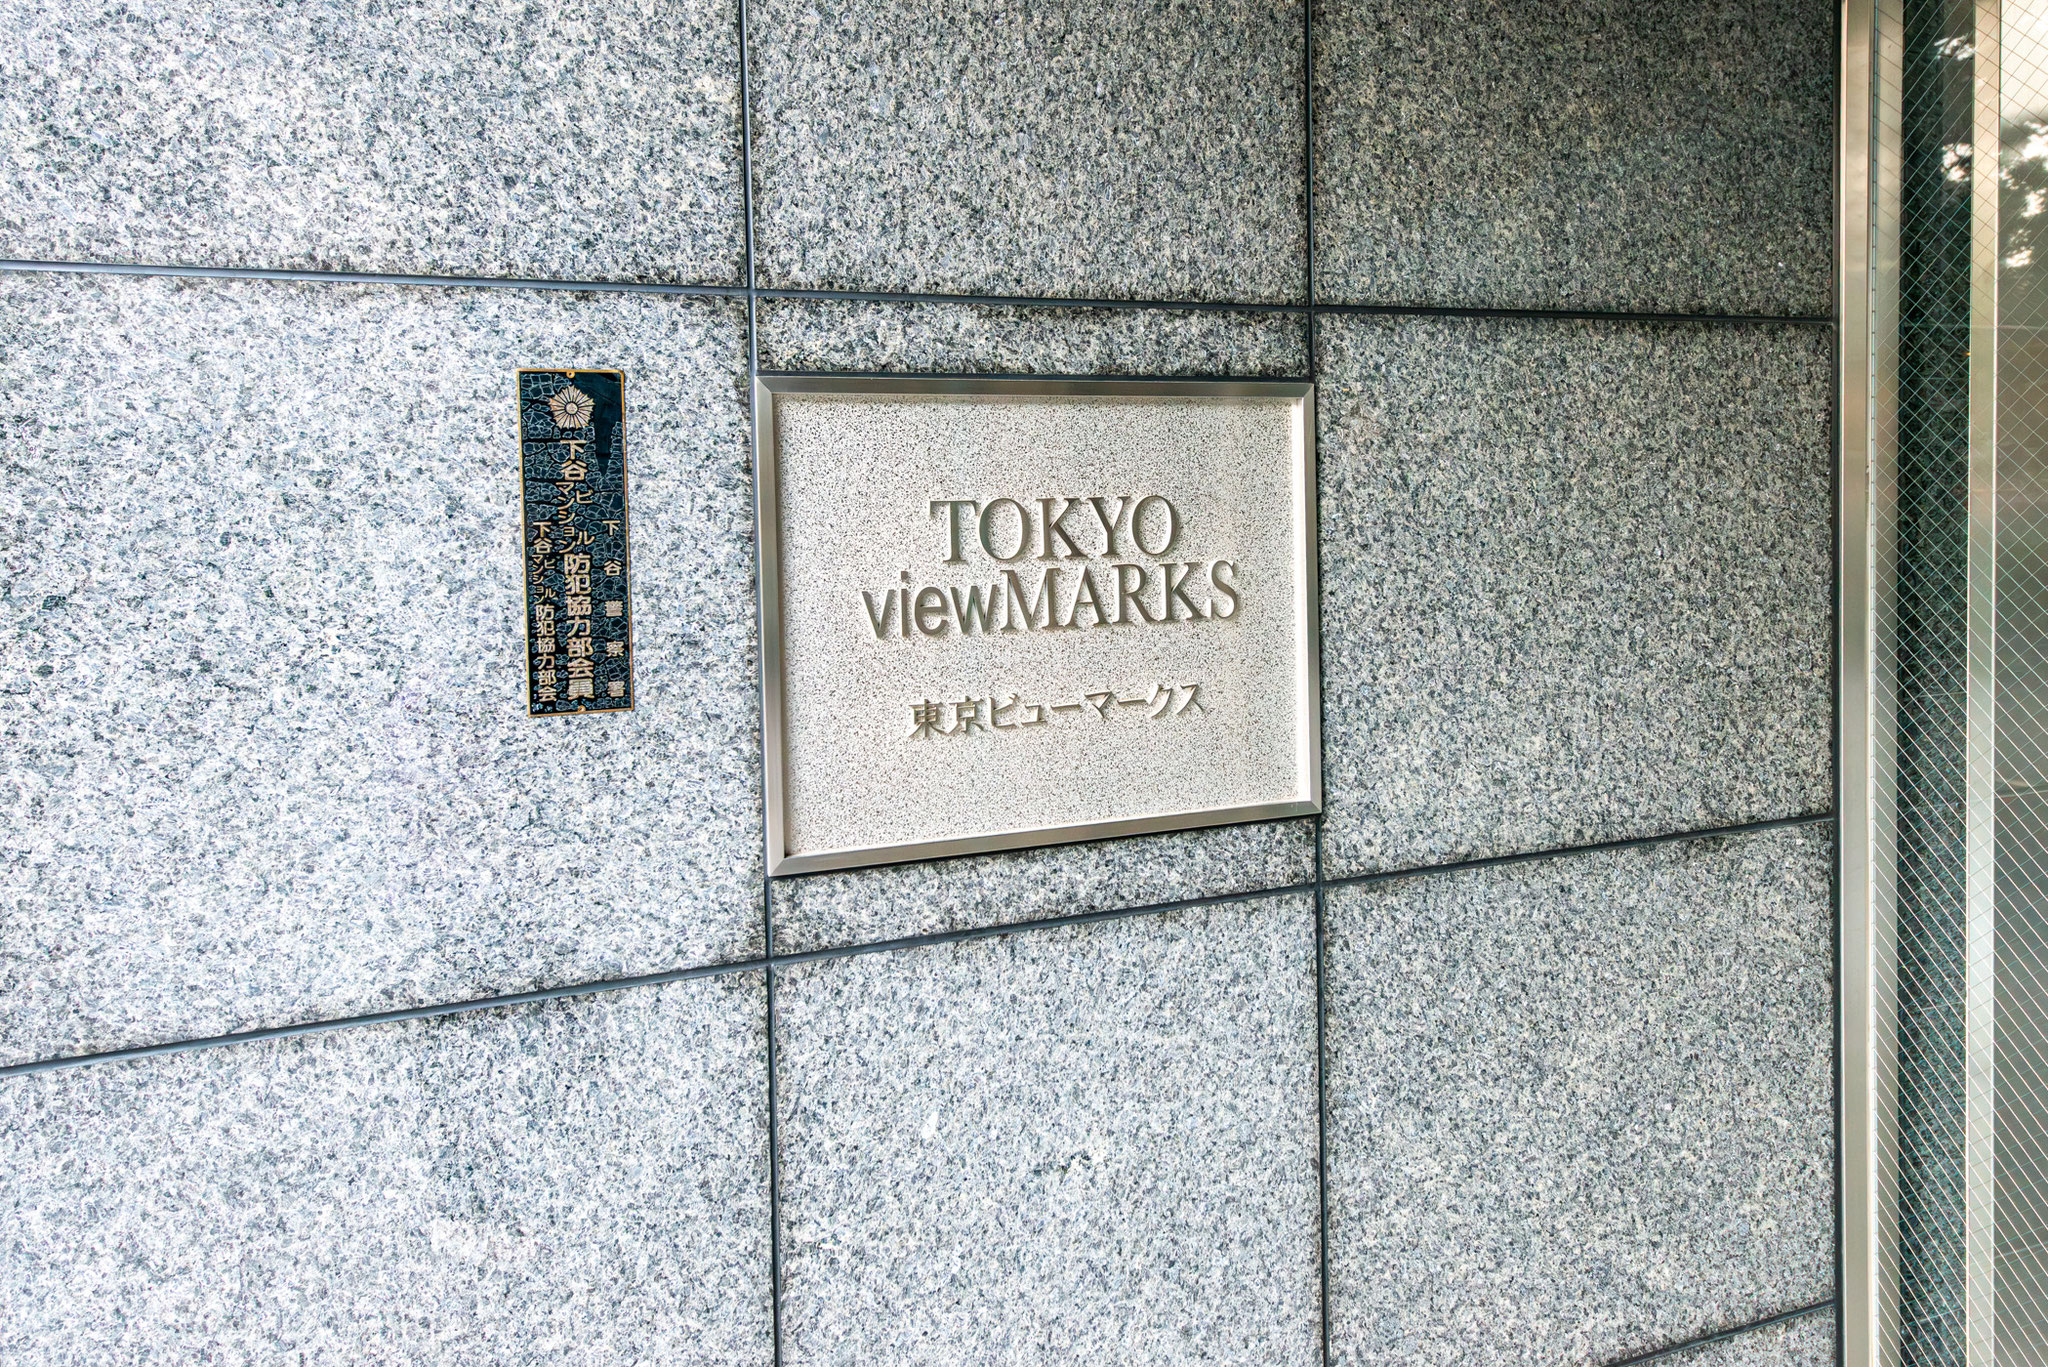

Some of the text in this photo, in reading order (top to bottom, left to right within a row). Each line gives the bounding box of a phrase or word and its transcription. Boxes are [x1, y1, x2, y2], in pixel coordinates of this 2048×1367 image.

[560, 439, 588, 481] 下谷
[929, 494, 1179, 564] TOKYO
[563, 552, 596, 700] 防犯協力部会員
[602, 519, 626, 698] 下谷警察署
[861, 559, 1239, 640] viewMARKS
[535, 604, 557, 702] 防犯協力部会
[907, 683, 1206, 739] 東京ビューマークス
